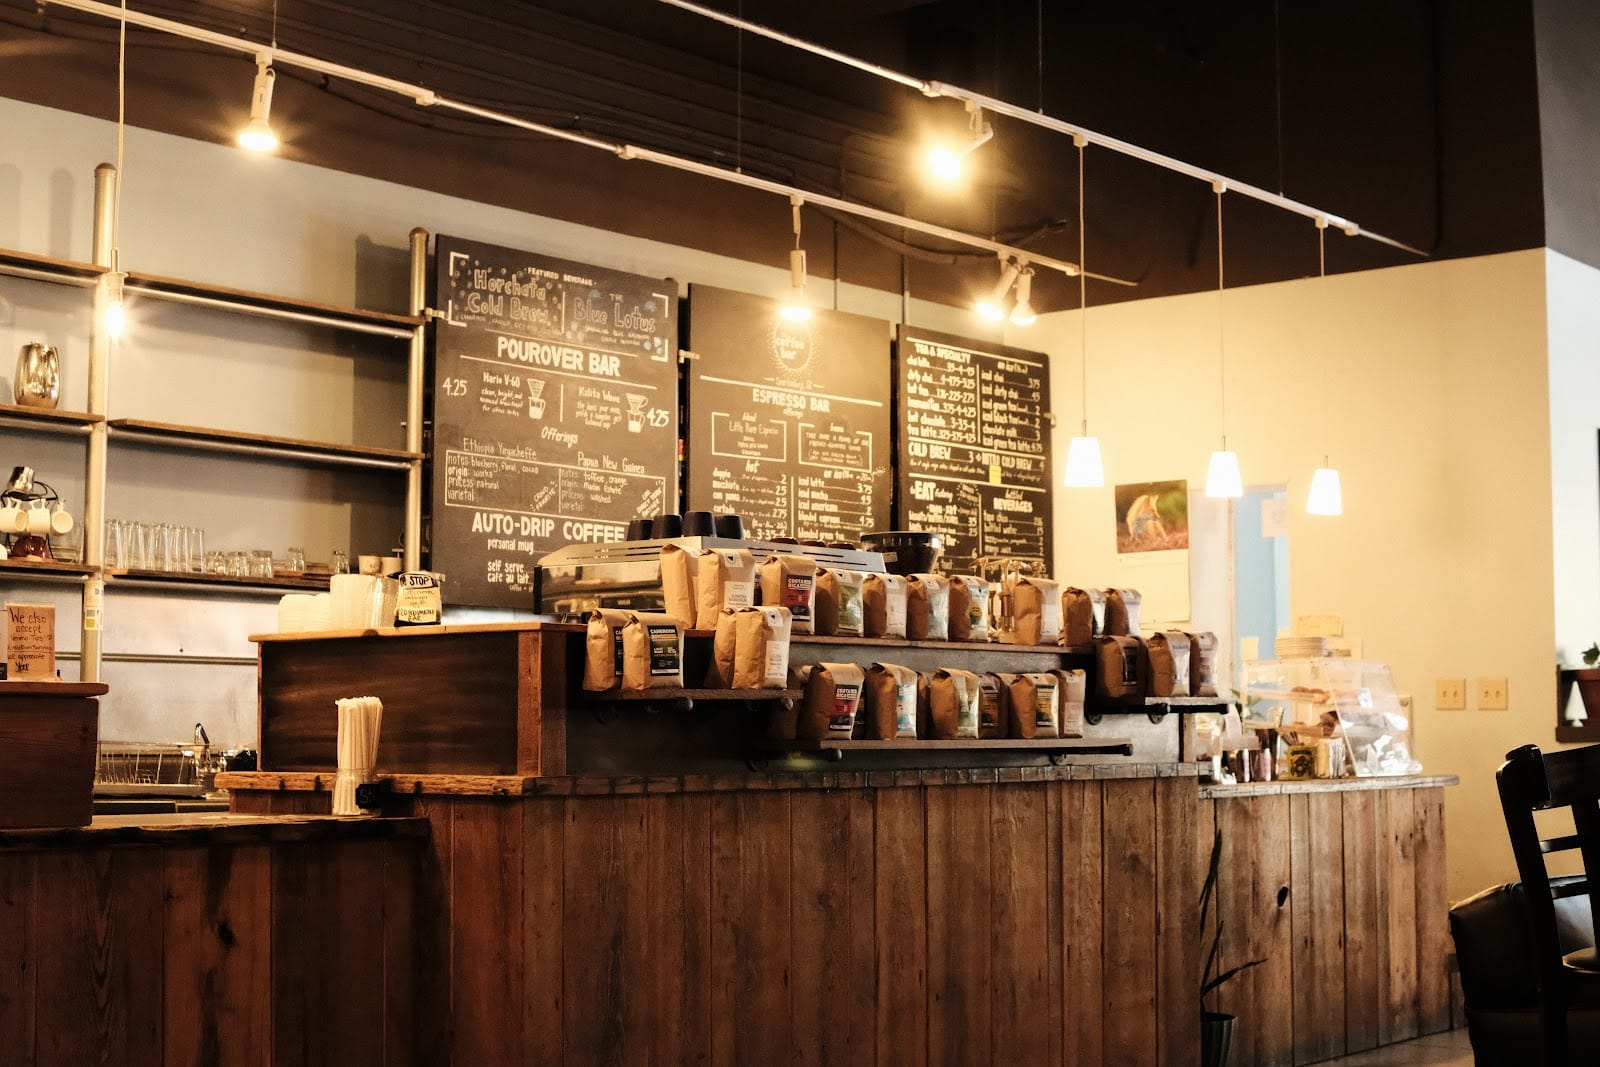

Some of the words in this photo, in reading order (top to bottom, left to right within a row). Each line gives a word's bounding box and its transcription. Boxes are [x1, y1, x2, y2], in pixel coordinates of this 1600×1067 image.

[528, 267, 559, 280] FEATURED
[474, 269, 546, 300] Horchata
[467, 292, 503, 316] Cold
[510, 296, 549, 323] Brew
[574, 296, 608, 325] Blue
[614, 302, 656, 333] Lotus
[497, 336, 584, 371] POUROVER
[589, 352, 621, 377] BAR
[442, 377, 468, 396] 4.25
[483, 371, 503, 384] Hario
[504, 374, 520, 388] V-60
[602, 389, 620, 403] Wave
[752, 388, 806, 409] ESPRESSO
[810, 397, 830, 413] BAR
[463, 437, 494, 455] Ethiopia
[541, 426, 578, 448] Offerings
[908, 442, 928, 457] COLD
[929, 444, 951, 460] BREW
[968, 451, 974, 463] 3
[578, 451, 599, 470] Papua
[602, 455, 617, 470] New
[622, 457, 645, 474] Guinea
[1001, 455, 1015, 468] COLD
[1016, 457, 1032, 471] BREW
[914, 480, 936, 501] EAT
[993, 497, 1033, 513] BEVERAGES
[471, 511, 555, 537] AUTO-DRIP
[563, 521, 625, 544] COFFEE
[487, 538, 516, 551] personal
[518, 541, 534, 555] mug
[487, 559, 501, 572] self
[504, 562, 524, 573] serve
[409, 575, 430, 586] STOP
[505, 573, 514, 584] au
[517, 573, 530, 584] lait
[9, 608, 24, 623] We
[28, 610, 46, 624] also
[16, 624, 42, 635] accept
